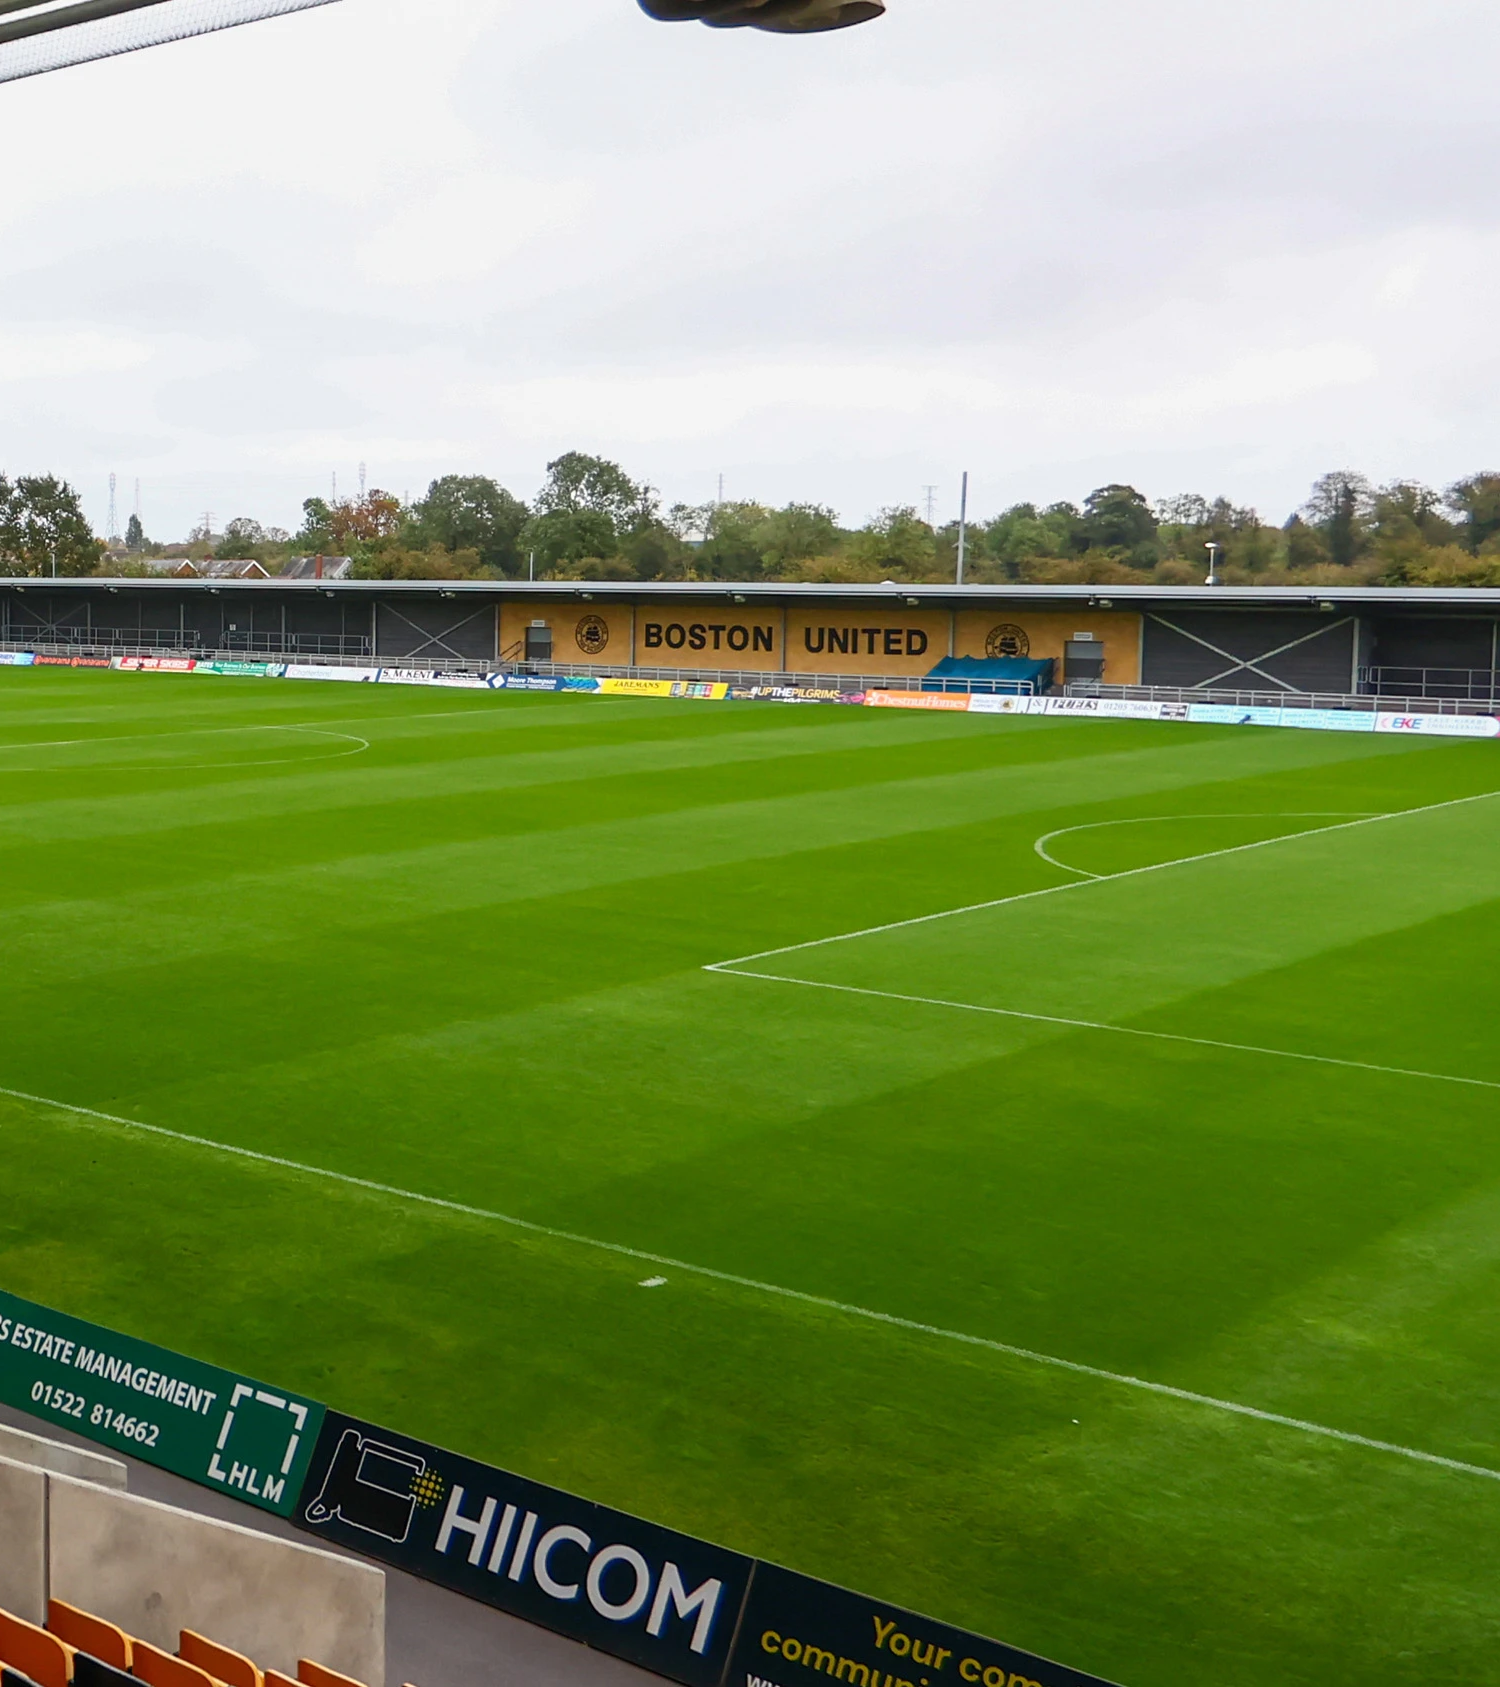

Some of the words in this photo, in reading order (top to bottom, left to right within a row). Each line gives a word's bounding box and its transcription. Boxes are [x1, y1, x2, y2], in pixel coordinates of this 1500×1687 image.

[644, 623, 773, 652] BOSTON
[804, 627, 929, 656] UNITED
[42, 657, 70, 665] vanarama
[79, 658, 109, 666] vanarama
[406, 671, 432, 679] KENT
[507, 676, 526, 684] Moore
[527, 677, 557, 687] Thompson
[614, 681, 660, 689] JAKEMANS
[750, 686, 840, 700] #UPTHEPILGRIMS
[1052, 699, 1099, 710] FUELS
[1392, 717, 1423, 730] EKE
[10, 1323, 76, 1366] ESTATE
[73, 1345, 218, 1415] MANAGEMENT
[30, 1380, 87, 1418] 01522
[89, 1403, 160, 1447] 814662
[227, 1461, 285, 1504] HLM
[434, 1484, 723, 1655] HIICOM
[871, 1615, 952, 1671] Your
[760, 1630, 930, 1687] commu
